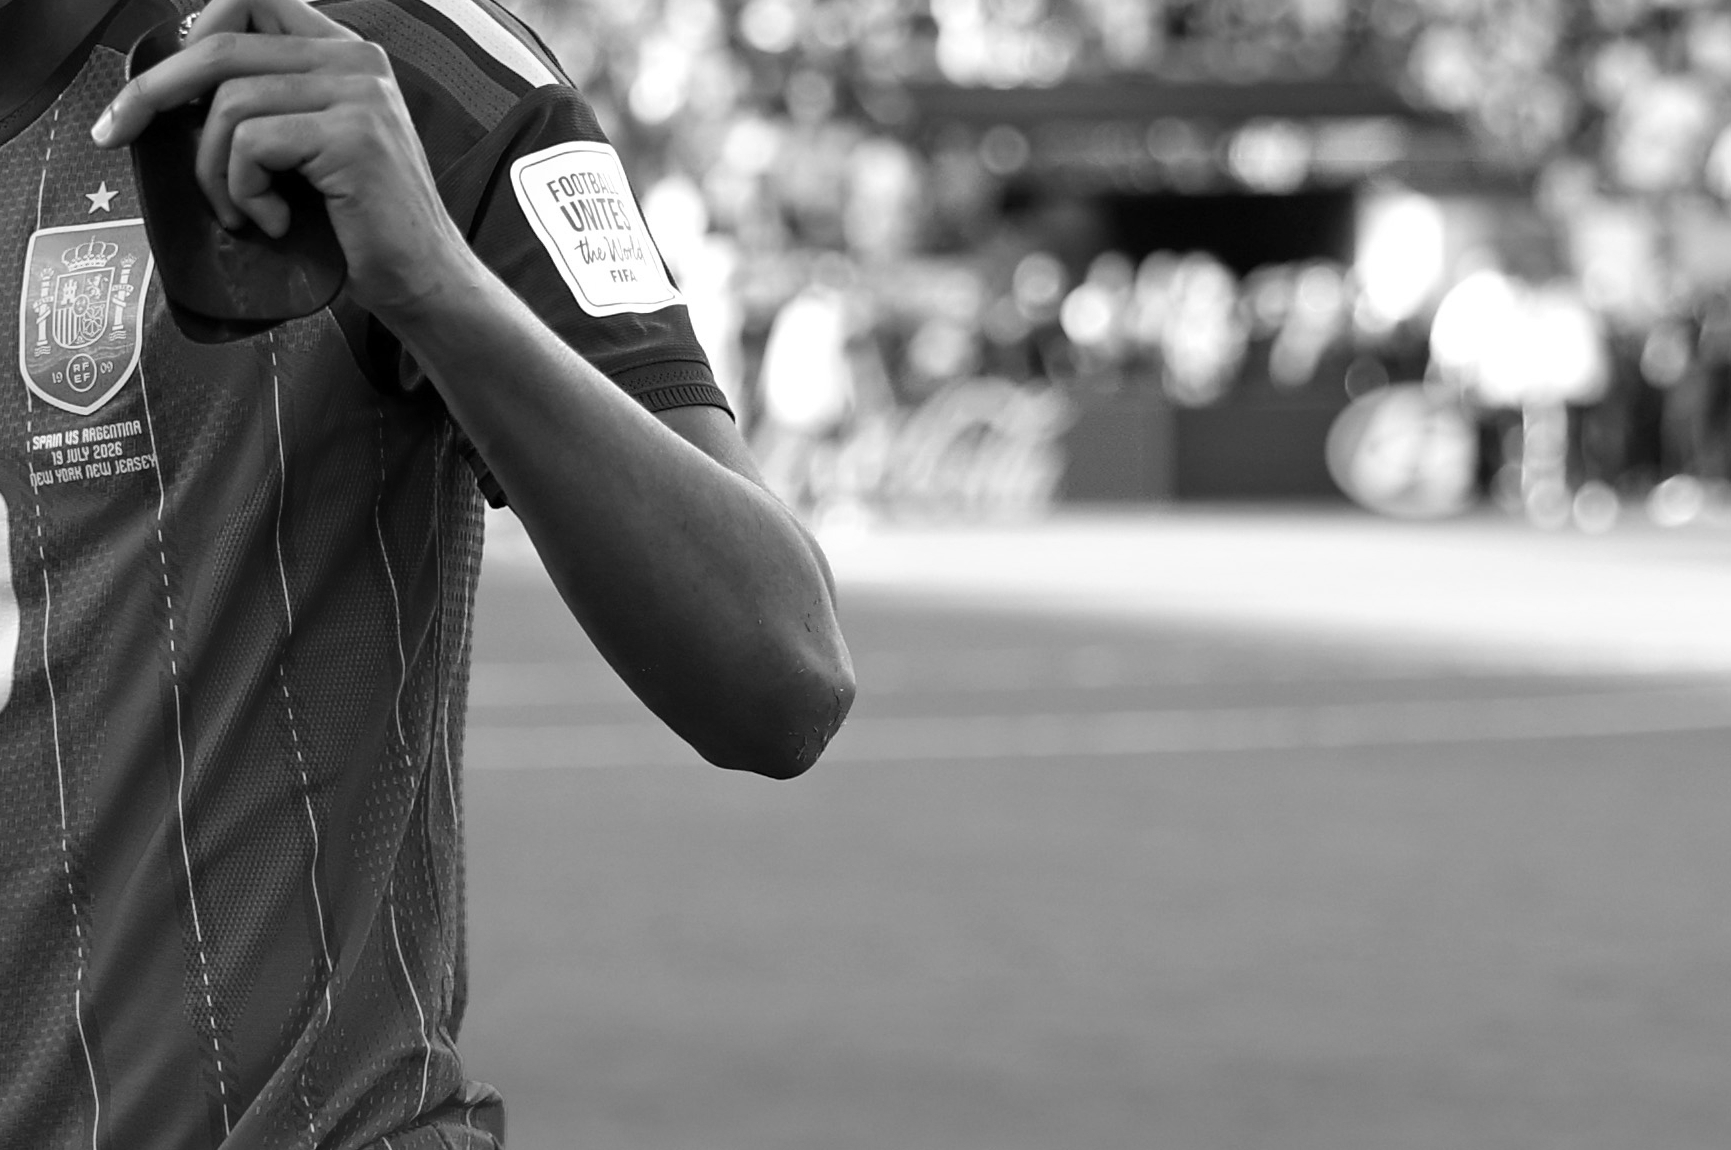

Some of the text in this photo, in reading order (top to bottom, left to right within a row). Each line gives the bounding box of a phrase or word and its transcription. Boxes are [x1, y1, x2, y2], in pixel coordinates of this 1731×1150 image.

[547, 172, 619, 202] FOOTBALL
[560, 198, 631, 232] UNITES
[574, 235, 647, 265] the World
[610, 269, 637, 282] FIFA
[52, 371, 63, 383] 19
[73, 361, 89, 372] RF
[74, 372, 90, 383] EF
[100, 361, 113, 373] 09
[32, 432, 63, 450] SPAIN
[82, 420, 142, 443] ARGENTINA
[51, 441, 123, 466] 19 JULY 2026
[30, 452, 156, 487] NEW YORK NEW JERSEY
